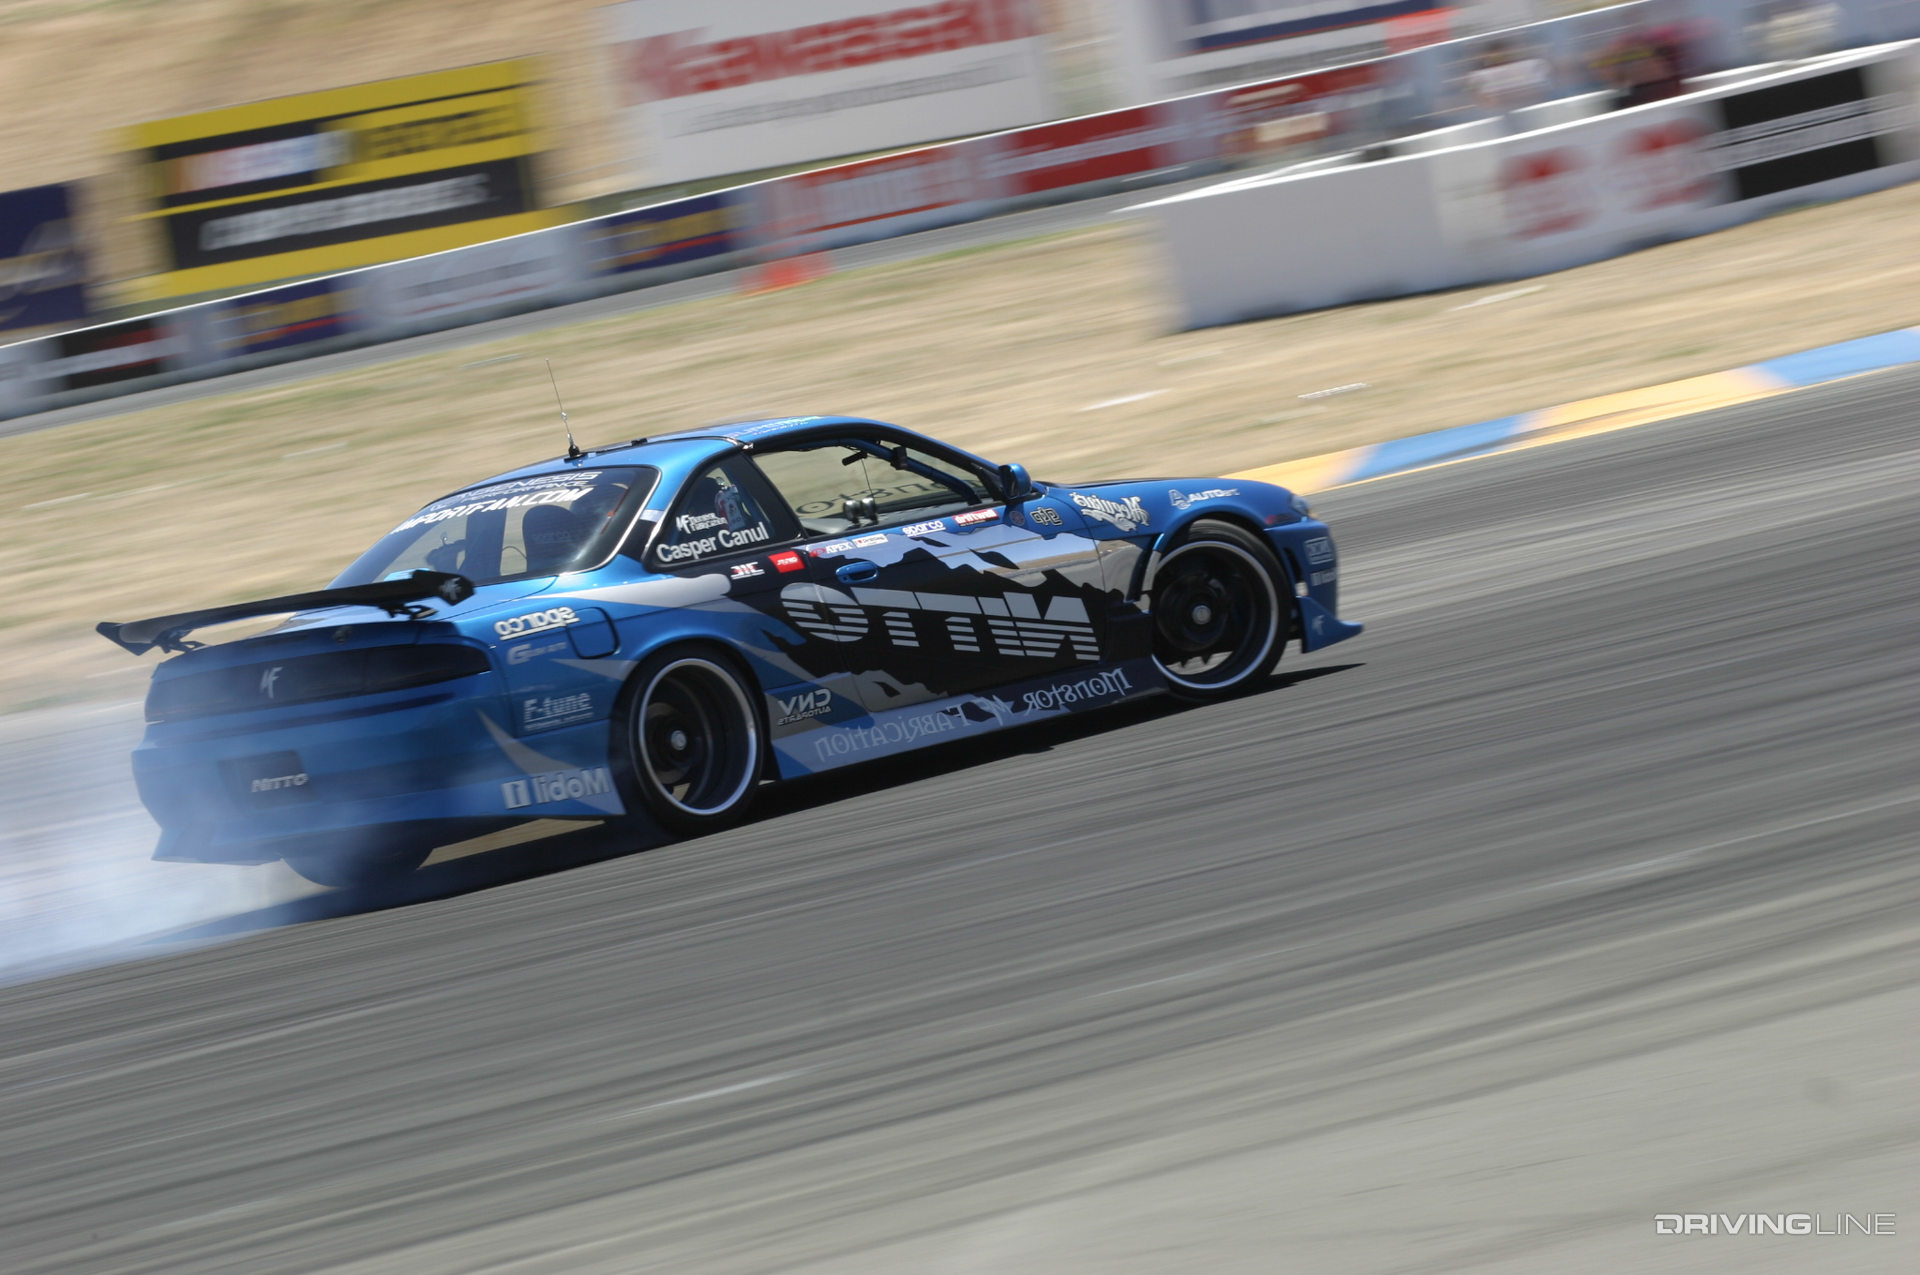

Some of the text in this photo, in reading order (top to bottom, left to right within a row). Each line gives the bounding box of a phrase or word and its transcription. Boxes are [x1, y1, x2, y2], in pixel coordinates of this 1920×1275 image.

[902, 520, 944, 535] sparco
[656, 522, 770, 562] Casper Canul
[251, 773, 309, 793] NITTO
